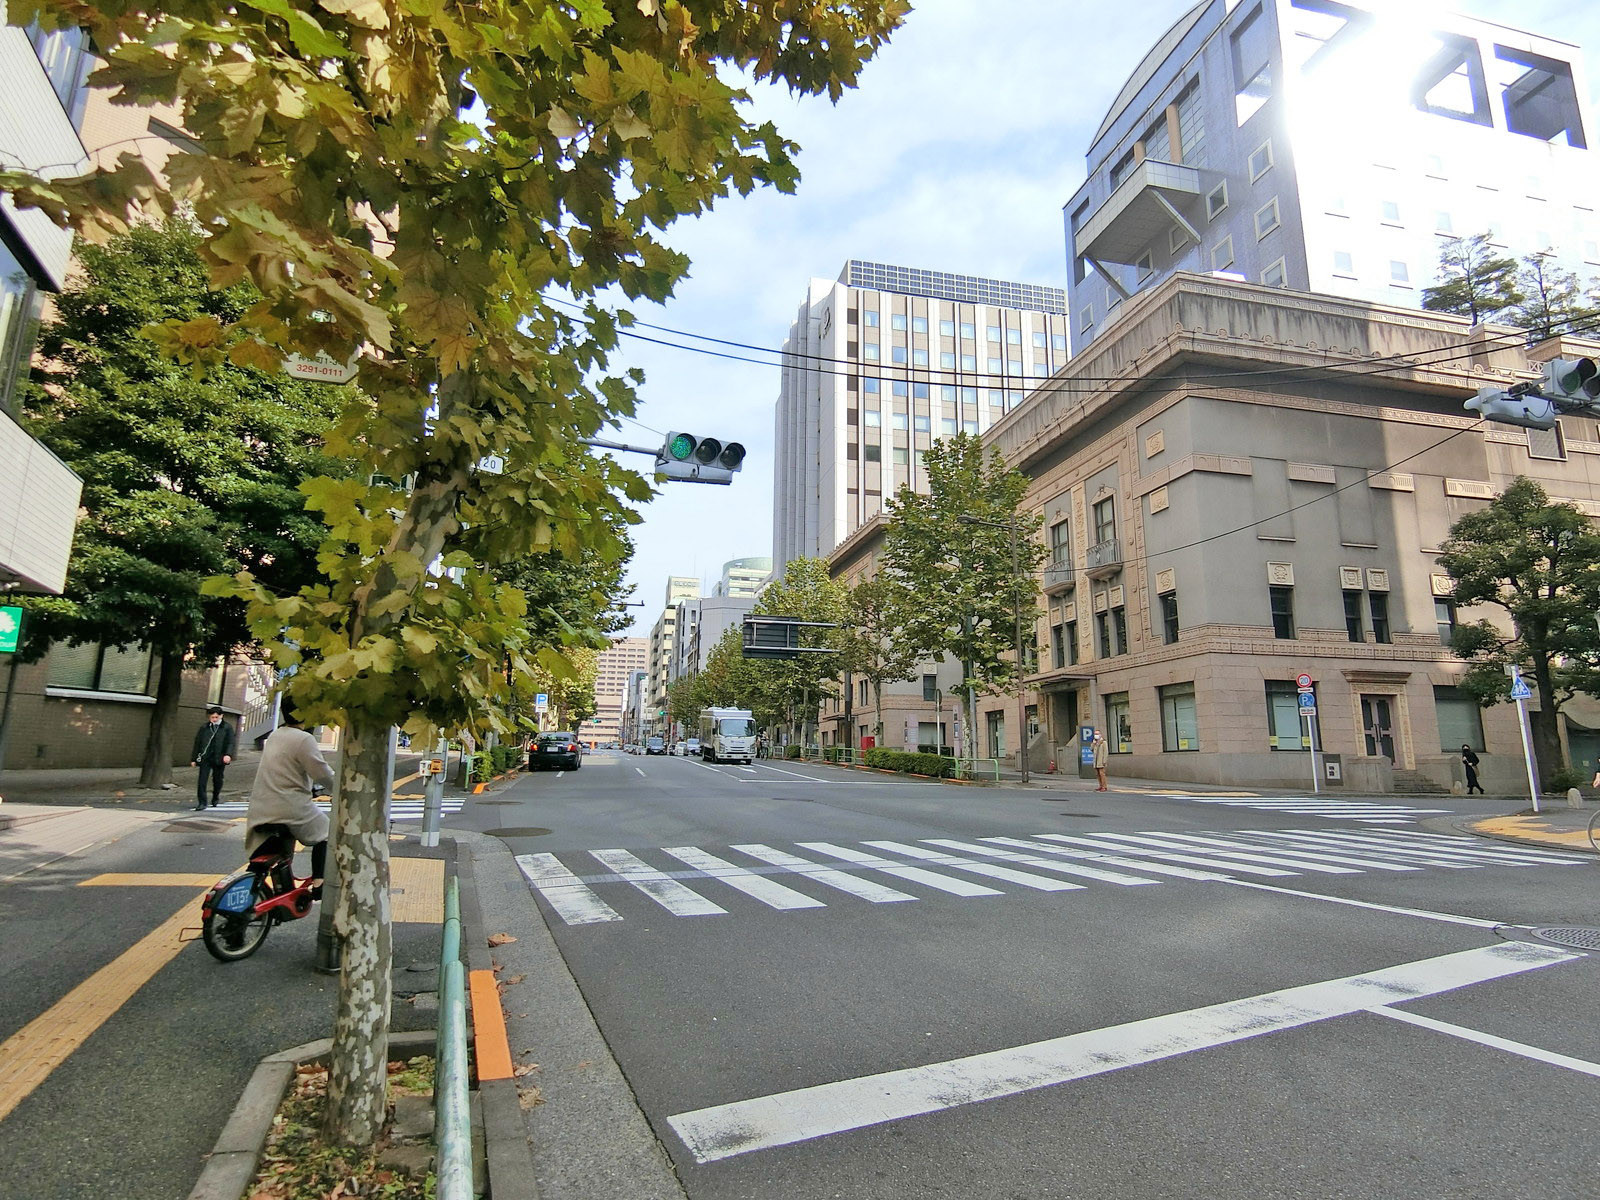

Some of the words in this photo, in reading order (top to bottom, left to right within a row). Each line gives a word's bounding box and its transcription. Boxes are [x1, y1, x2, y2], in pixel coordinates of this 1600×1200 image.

[296, 364, 342, 377] 3291-0111
[483, 457, 496, 469] 20
[1082, 728, 1093, 741] P
